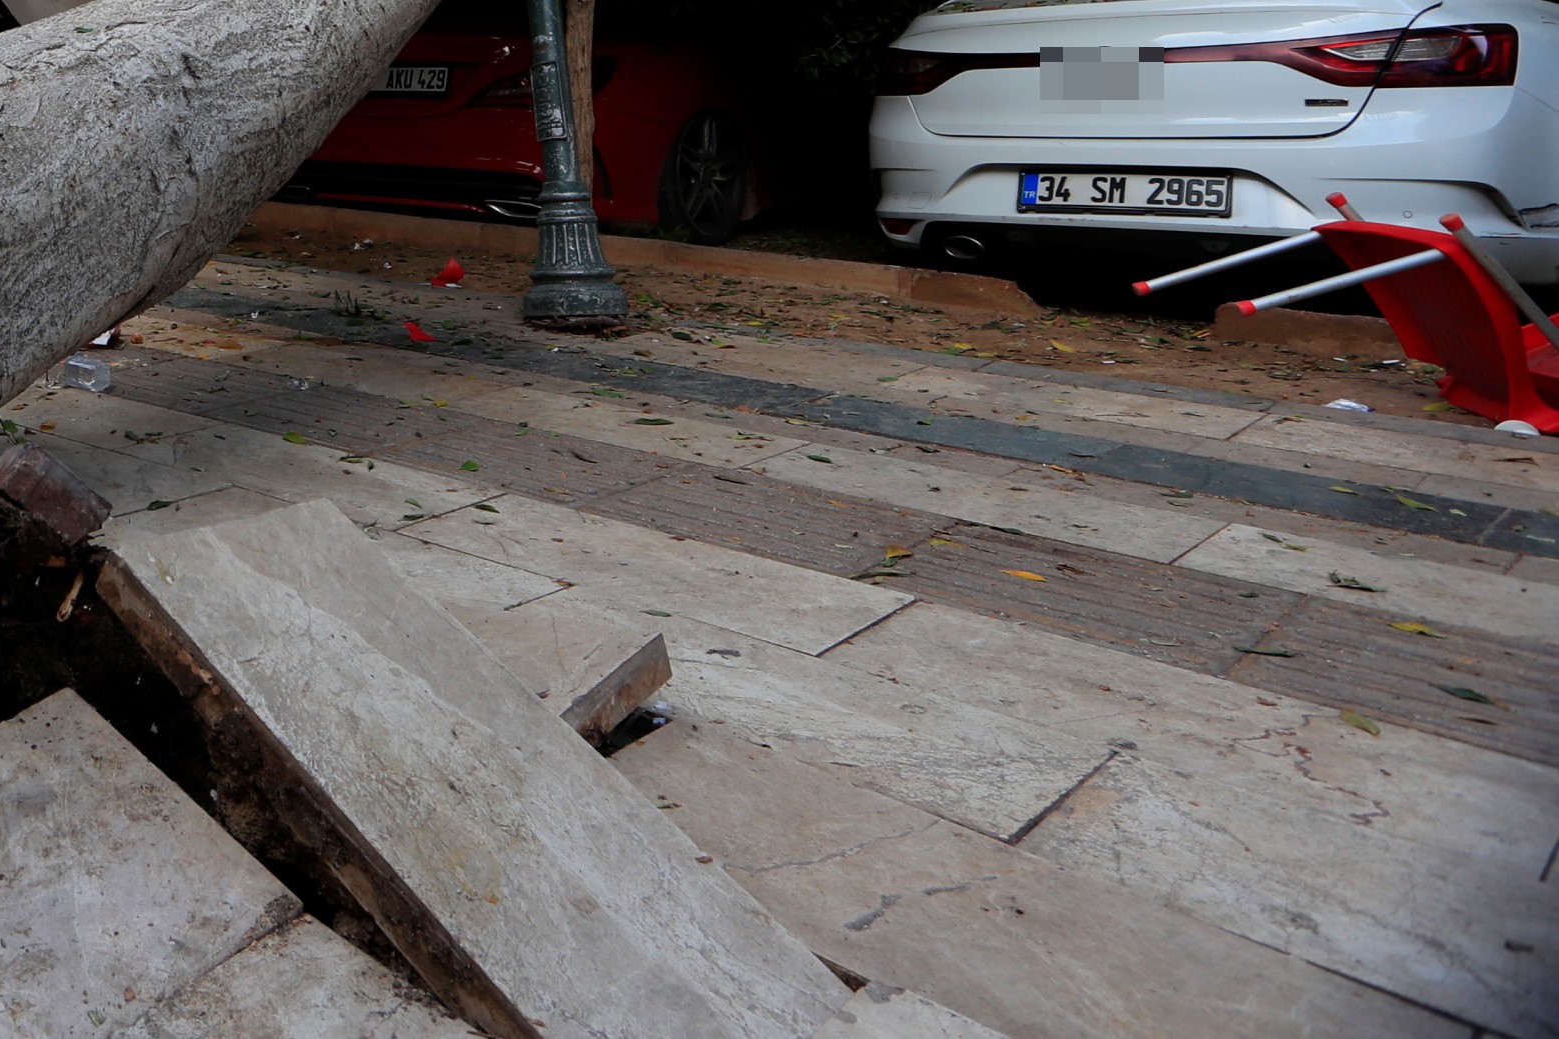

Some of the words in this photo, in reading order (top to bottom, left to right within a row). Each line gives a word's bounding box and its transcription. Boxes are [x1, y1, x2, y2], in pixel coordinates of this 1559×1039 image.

[385, 69, 414, 89] AKU
[417, 69, 447, 89] 429
[1023, 190, 1036, 199] TR
[1038, 176, 1071, 203] 34
[1090, 176, 1127, 204] SM
[1146, 177, 1226, 208] 2965
